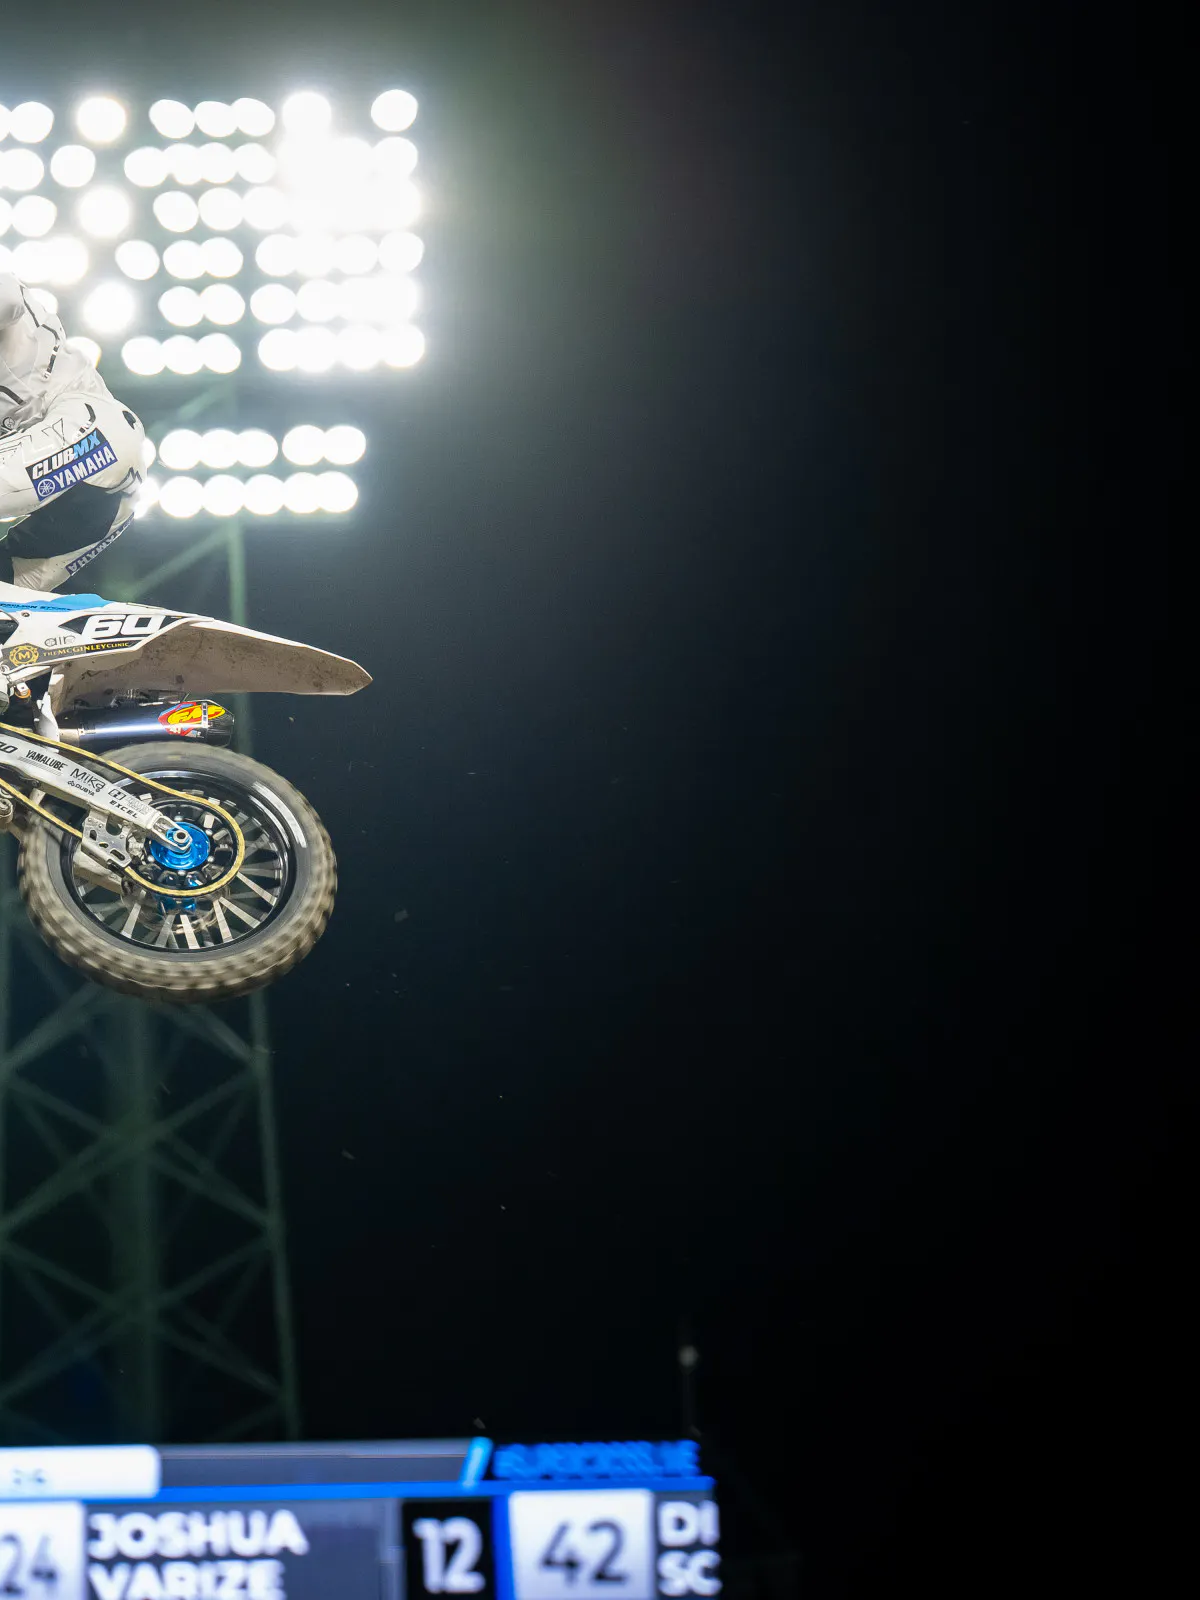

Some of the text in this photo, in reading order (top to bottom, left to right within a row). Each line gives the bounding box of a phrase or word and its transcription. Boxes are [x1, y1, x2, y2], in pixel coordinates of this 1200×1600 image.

[31, 429, 101, 480] CLUBMX
[53, 445, 116, 489] YAMAHA
[81, 614, 164, 641] 60
[25, 749, 67, 772] YAMALUBE
[109, 799, 138, 819] EXCEL
[87, 1508, 309, 1559] JOSHUA
[413, 1516, 486, 1593] 12
[538, 1519, 629, 1585] 42
[88, 1558, 289, 1600] VARIZE
